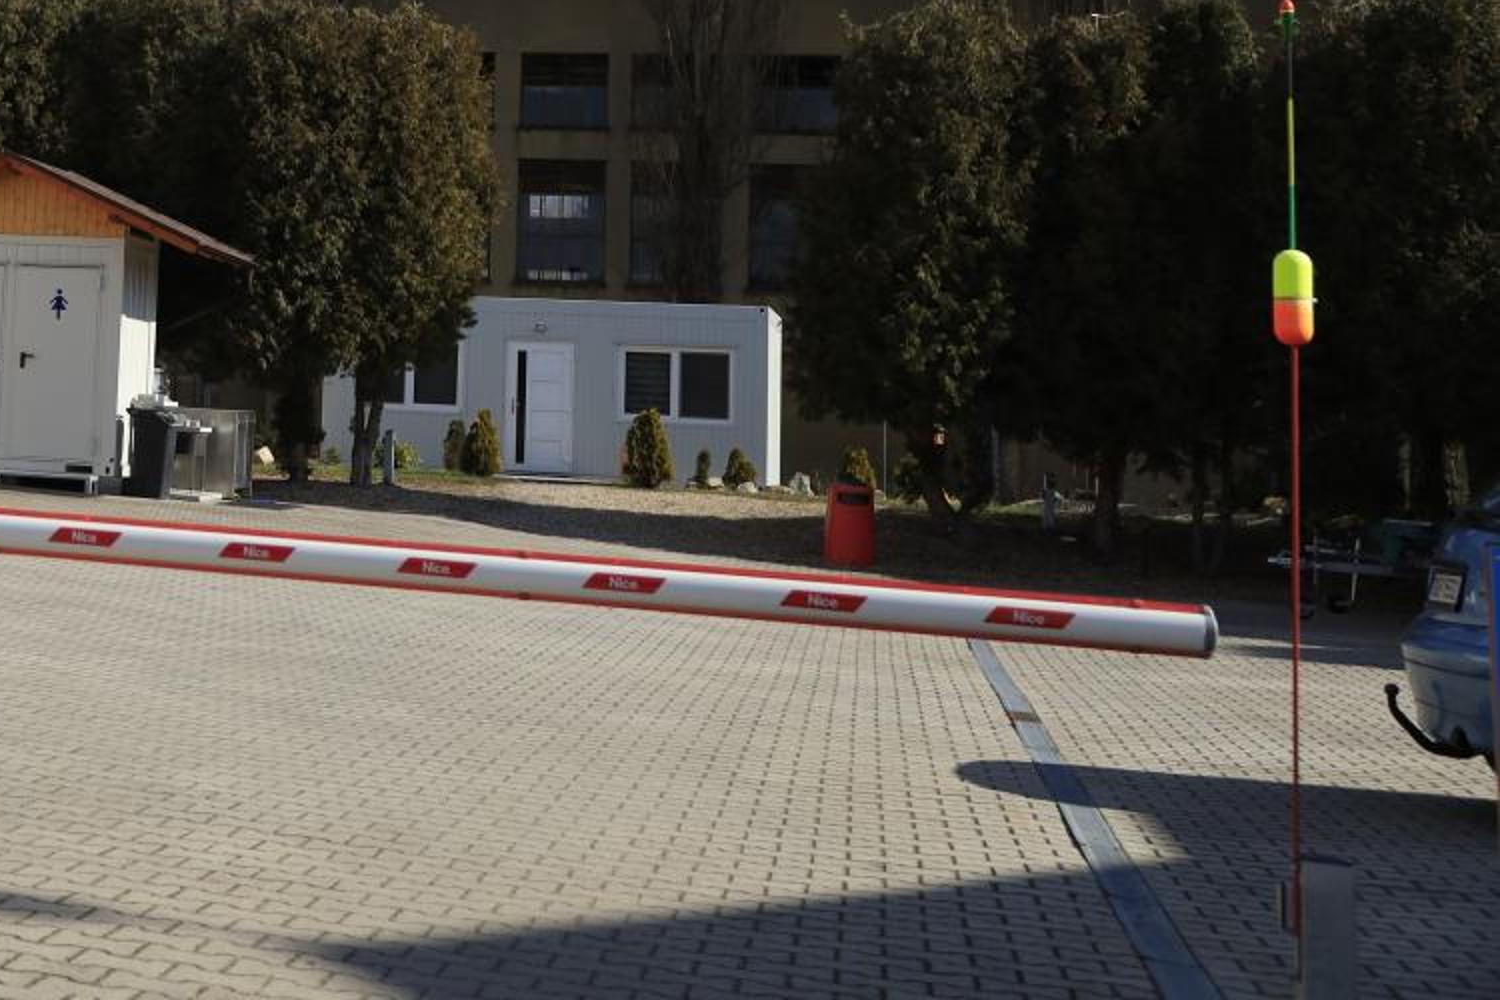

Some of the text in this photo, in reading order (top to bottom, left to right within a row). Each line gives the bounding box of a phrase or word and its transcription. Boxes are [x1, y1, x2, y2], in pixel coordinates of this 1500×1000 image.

[72, 531, 97, 543] Nice
[243, 546, 269, 558] Nice
[422, 561, 451, 573] Nice
[609, 576, 638, 590] Nice
[807, 594, 837, 609] Nice
[1013, 610, 1045, 625] Nice
